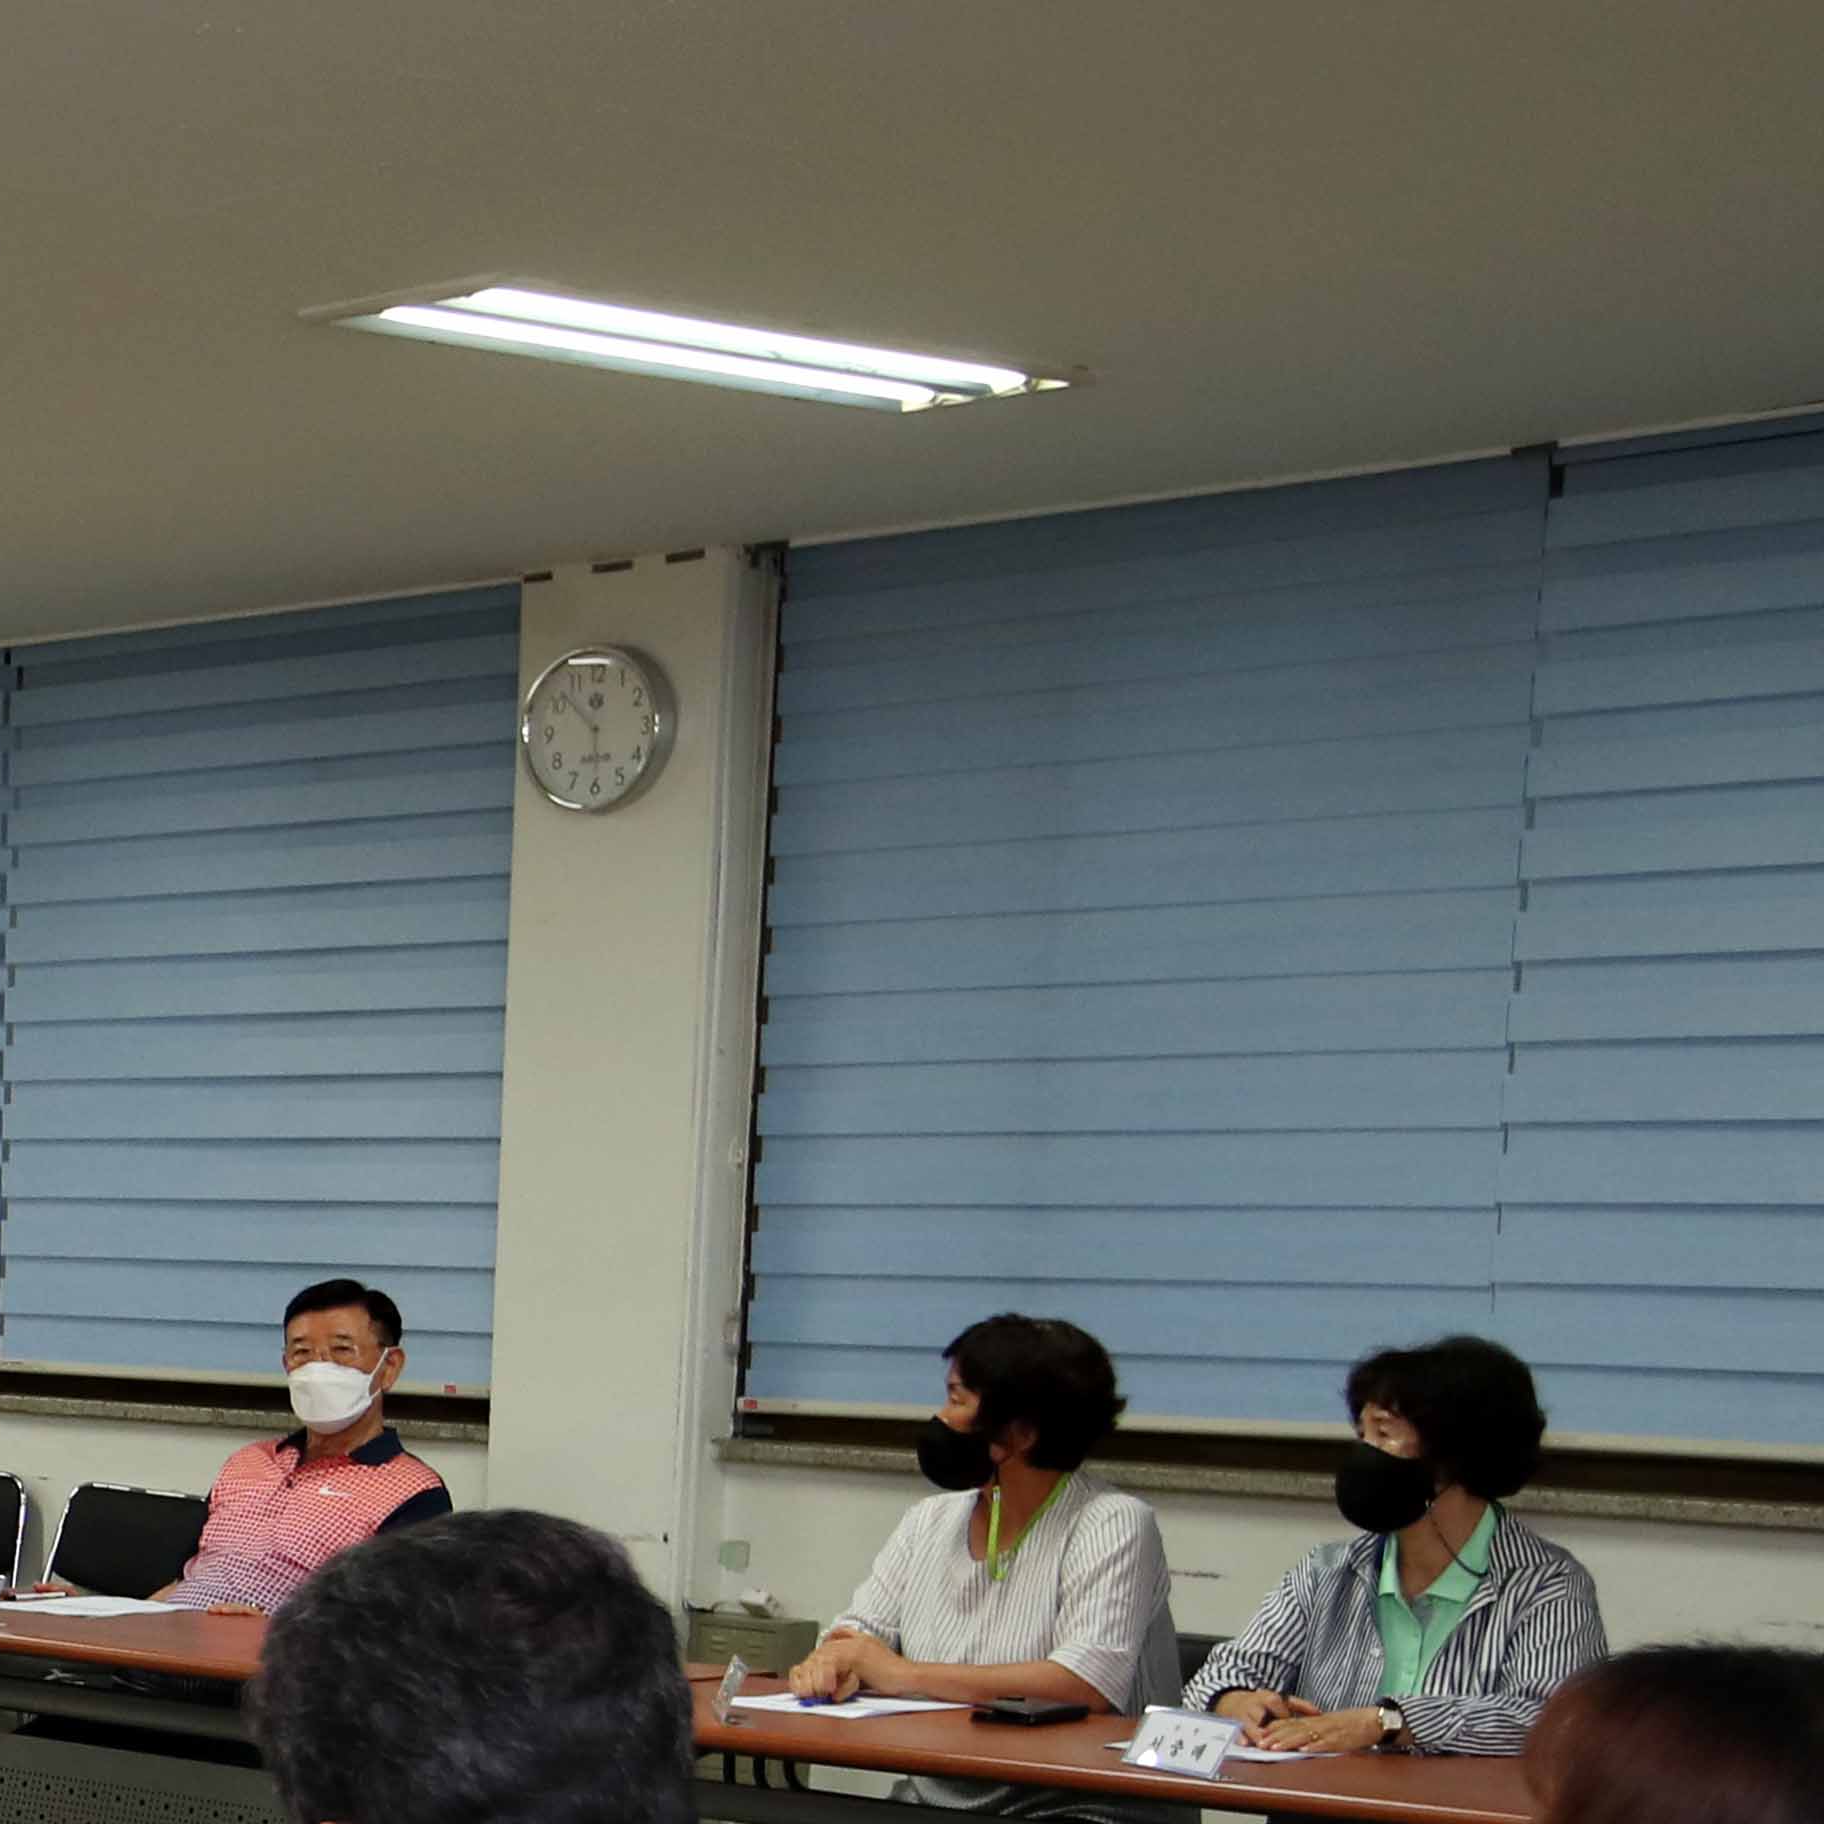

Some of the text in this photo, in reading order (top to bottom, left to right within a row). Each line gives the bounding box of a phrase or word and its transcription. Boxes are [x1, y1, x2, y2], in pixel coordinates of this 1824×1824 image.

[632, 688, 643, 707] 2
[641, 715, 650, 735] 3
[544, 726, 554, 744] 9
[552, 752, 562, 770] 8
[568, 770, 579, 790] 7
[590, 777, 600, 795] 6
[614, 767, 625, 786] 5
